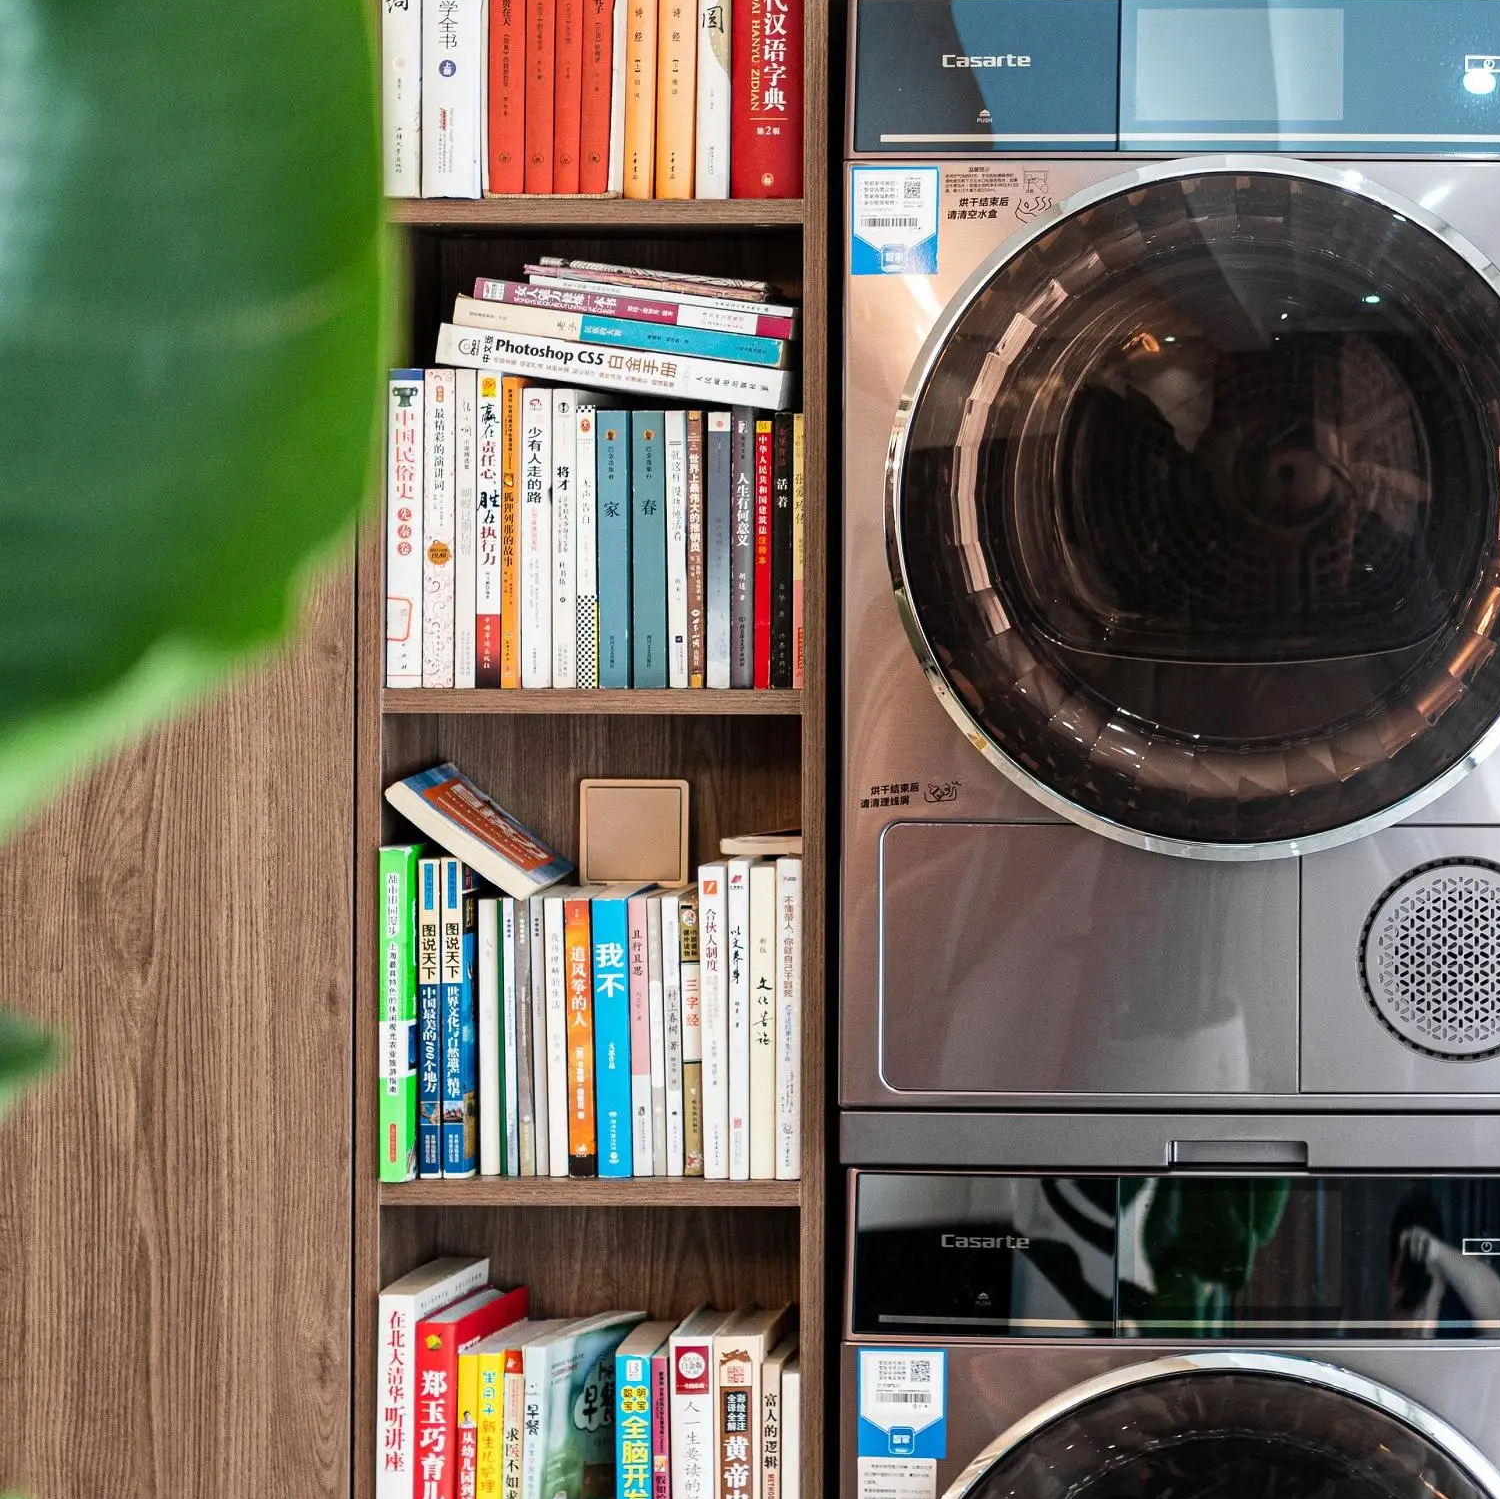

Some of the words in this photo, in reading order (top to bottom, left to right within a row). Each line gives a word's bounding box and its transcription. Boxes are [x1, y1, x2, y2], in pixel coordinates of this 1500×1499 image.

[633, 7, 644, 43] 诗经
[671, 7, 682, 43] 诗经
[752, 18, 761, 65] HANYU
[942, 53, 1031, 68] Casarte
[751, 67, 760, 112] ZIDIAN
[756, 125, 781, 137] 第2版
[947, 210, 998, 220] 请清空水盒
[959, 196, 1010, 207] 烘干结束后
[482, 335, 495, 363] 中文版
[495, 339, 574, 365] Photoshop
[577, 350, 604, 367] CS5
[607, 353, 678, 379] 白金手册
[394, 409, 416, 501] 中国民俗史
[434, 407, 446, 492] 最精彩的演讲词
[527, 426, 543, 504] 少有人走的路
[556, 465, 571, 492] 将才
[776, 477, 789, 509] 活着
[603, 500, 621, 519] 家
[641, 498, 658, 517] 春
[688, 453, 701, 553] 世界上最伟大的推销员
[736, 472, 750, 547] 人生有何意义
[860, 795, 911, 810] 请清理线屑
[870, 782, 921, 796] 烘干结束后
[422, 924, 437, 980] 图说天下
[445, 922, 460, 979] 图说天下
[631, 929, 644, 976] 且行且思
[705, 908, 719, 972] 合伙人制度
[570, 945, 588, 1028] 追风筝的人
[595, 941, 625, 998] 我不
[667, 990, 679, 1035] 村上春树
[684, 978, 699, 1028] 三字经
[422, 986, 437, 1094] 中国最美的100个地方
[446, 985, 461, 1099] 世界文化与自然遗产精华
[941, 1233, 1031, 1249] Casarte
[384, 1310, 406, 1473] 在北大清华听讲座
[525, 1404, 540, 1437] 早餐
[763, 1393, 778, 1470] 富人的逻辑
